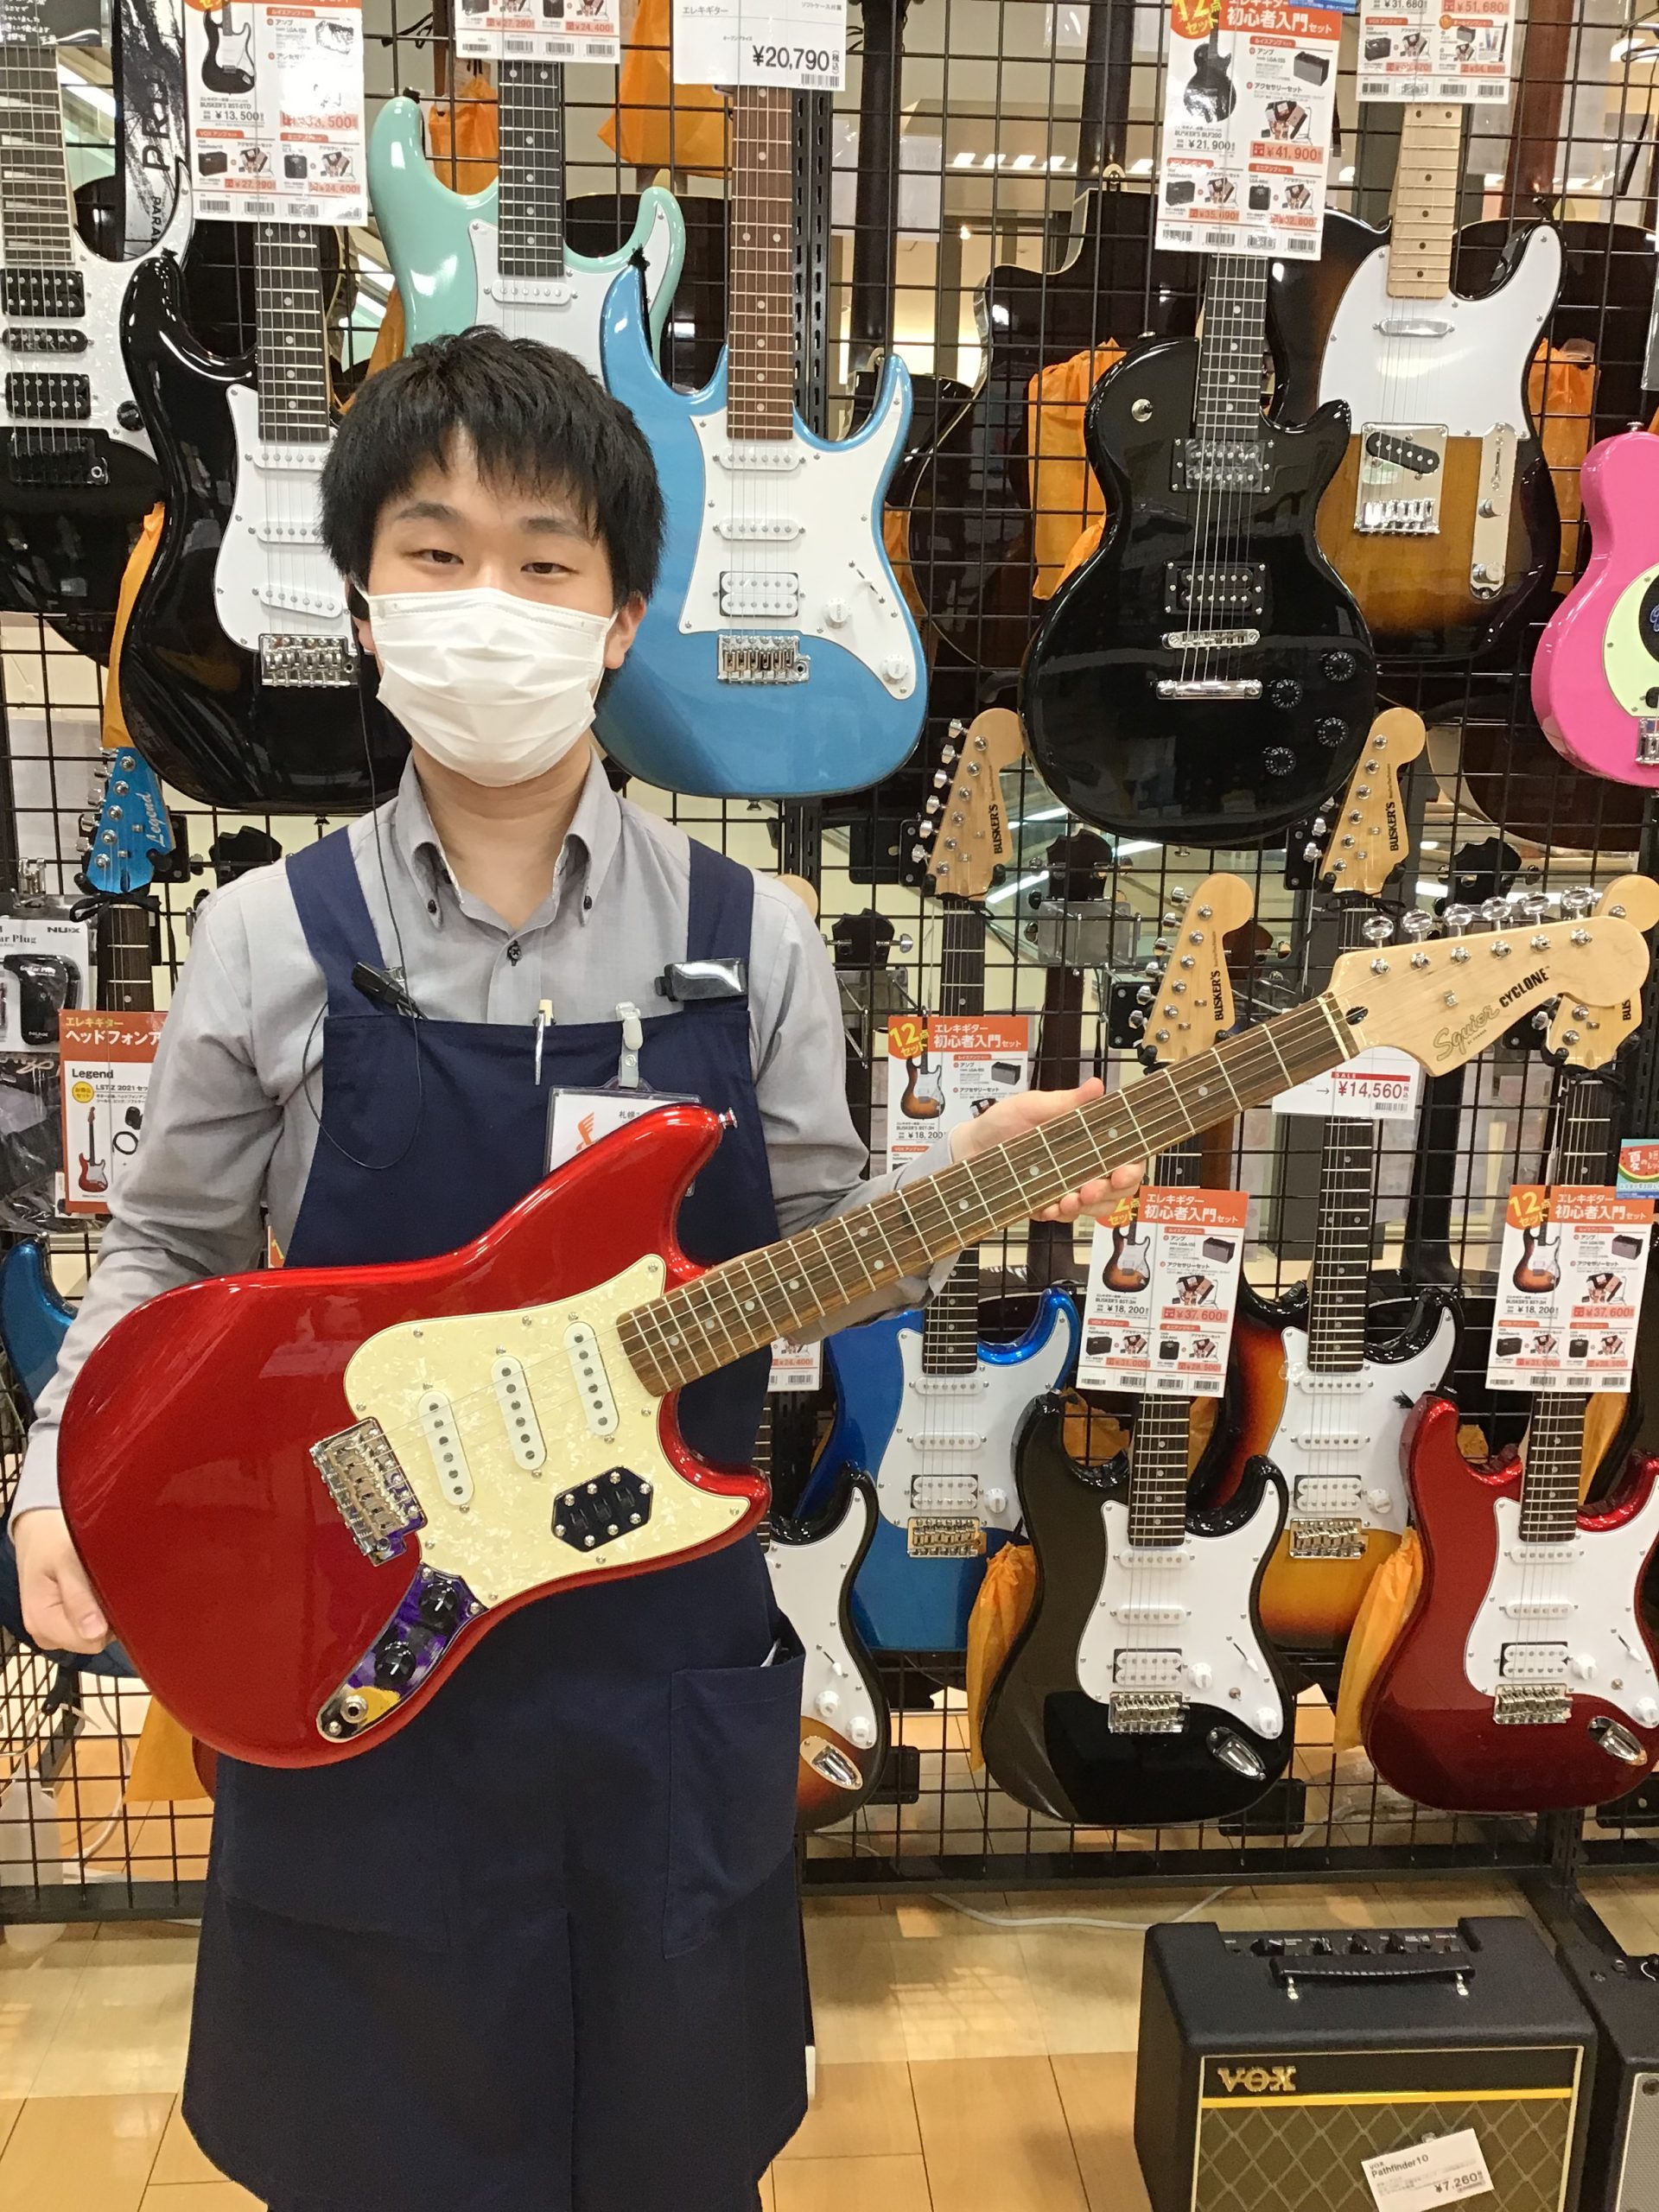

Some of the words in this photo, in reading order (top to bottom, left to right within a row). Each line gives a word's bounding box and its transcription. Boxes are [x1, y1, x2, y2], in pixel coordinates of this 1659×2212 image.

[683, 6, 728, 15] エレキギター
[1458, 1, 1504, 13] ¥51,680
[1227, 8, 1332, 34] 初心者入門セット
[753, 45, 830, 72] ¥20,790
[1255, 82, 1302, 92] アクセサリーセット
[215, 111, 259, 121] ¥13,500
[1188, 140, 1231, 150] ¥21,900
[1266, 145, 1318, 161] ¥41,900
[135, 791, 167, 848] Legend
[988, 804, 1003, 855] BUSKER'S
[1385, 801, 1400, 852] BUSKER'S
[13, 935, 36, 944] Plug
[1210, 969, 1224, 1021] BUSKER'S
[1433, 1005, 1500, 1061] Squier
[1499, 968, 1549, 1007] CYCLONE
[66, 1017, 124, 1027] エレキギター
[934, 1024, 988, 1033] エレキギター
[66, 1030, 162, 1046] ヘッドフォンア
[933, 1034, 1021, 1048] 初心者入門セット
[72, 1068, 114, 1079] Legend
[1338, 1081, 1402, 1099] ¥14,560
[908, 1131, 944, 1140] ¥18,200
[1147, 1193, 1205, 1204] エレキギター
[1557, 1194, 1614, 1205] エレキギター
[1144, 1204, 1238, 1224] 初心者入門セット
[1555, 1205, 1647, 1221] 初心者入門セット
[1107, 1305, 1145, 1314] ¥18,200
[1177, 1309, 1223, 1321] ¥37,600
[1517, 1306, 1555, 1314] ¥18,200
[1586, 1306, 1630, 1317] ¥37,600
[1217, 2065, 1297, 2093] VOX
[1371, 2154, 1429, 2178] Pathfinder10
[1434, 2172, 1478, 2193] ¥7,260
